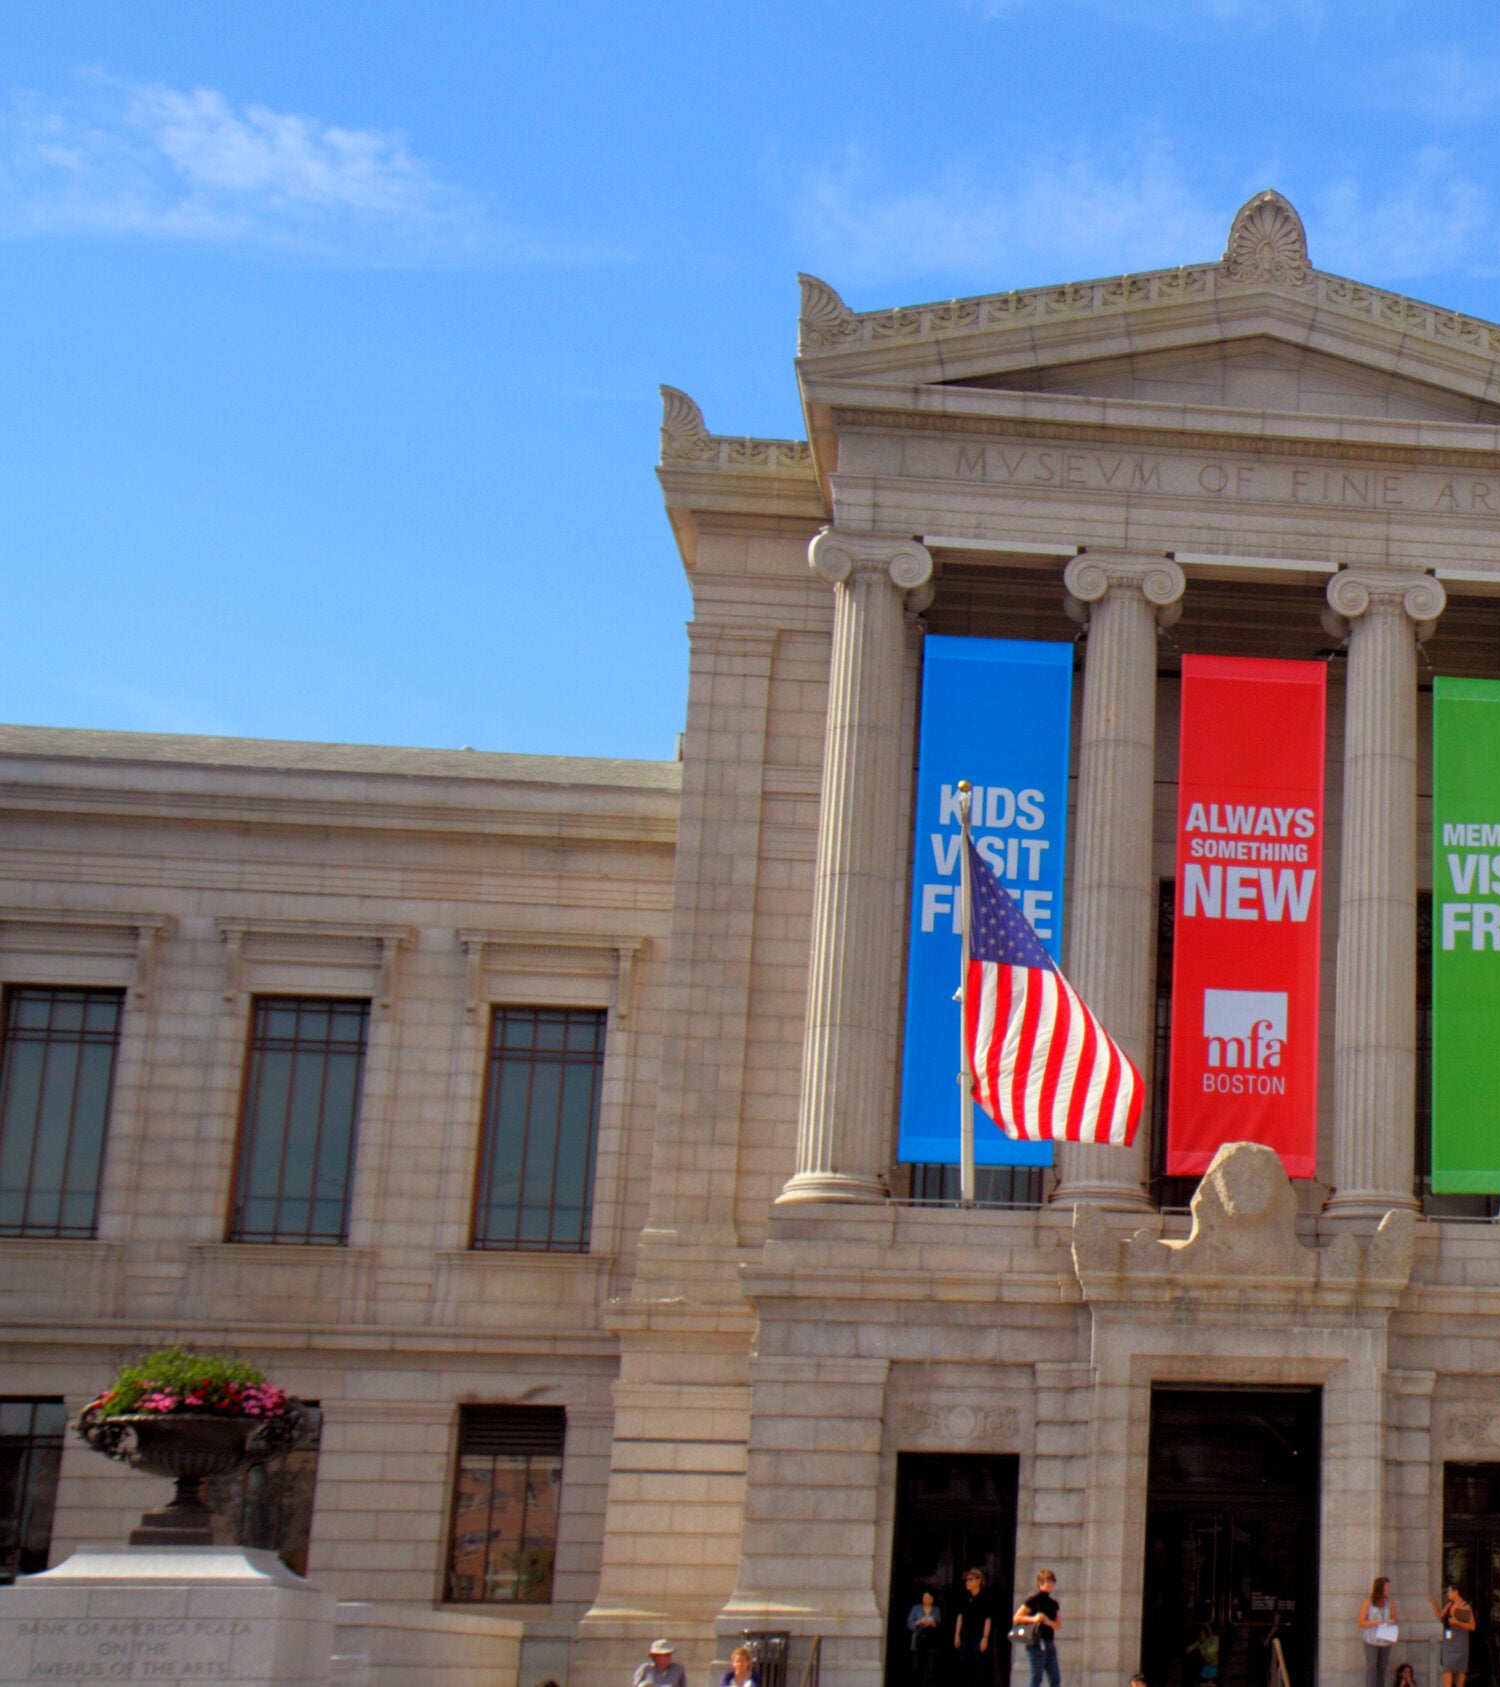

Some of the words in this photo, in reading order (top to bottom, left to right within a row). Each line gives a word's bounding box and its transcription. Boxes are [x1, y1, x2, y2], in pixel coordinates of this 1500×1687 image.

[1199, 464, 1255, 493] OF
[1290, 470, 1403, 505] FINE
[939, 784, 1045, 831] KIDS
[1185, 802, 1315, 838] ALWAYS
[930, 833, 1050, 881] VSIT
[1190, 838, 1308, 862] SOMETHING
[921, 884, 1053, 939] FE
[1183, 863, 1317, 922] NEW
[1203, 1020, 1288, 1068] mfa
[1203, 1073, 1285, 1095] BOSTON
[17, 1623, 66, 1636] BANK
[74, 1623, 99, 1636] OF
[107, 1623, 186, 1636] AMERICA
[194, 1623, 251, 1636] PLAZA
[97, 1642, 128, 1656] ON
[134, 1642, 169, 1655] THE
[31, 1662, 105, 1676] AVENUE
[110, 1662, 133, 1676] OF
[142, 1662, 175, 1676] THE
[180, 1662, 226, 1676] ARTS
